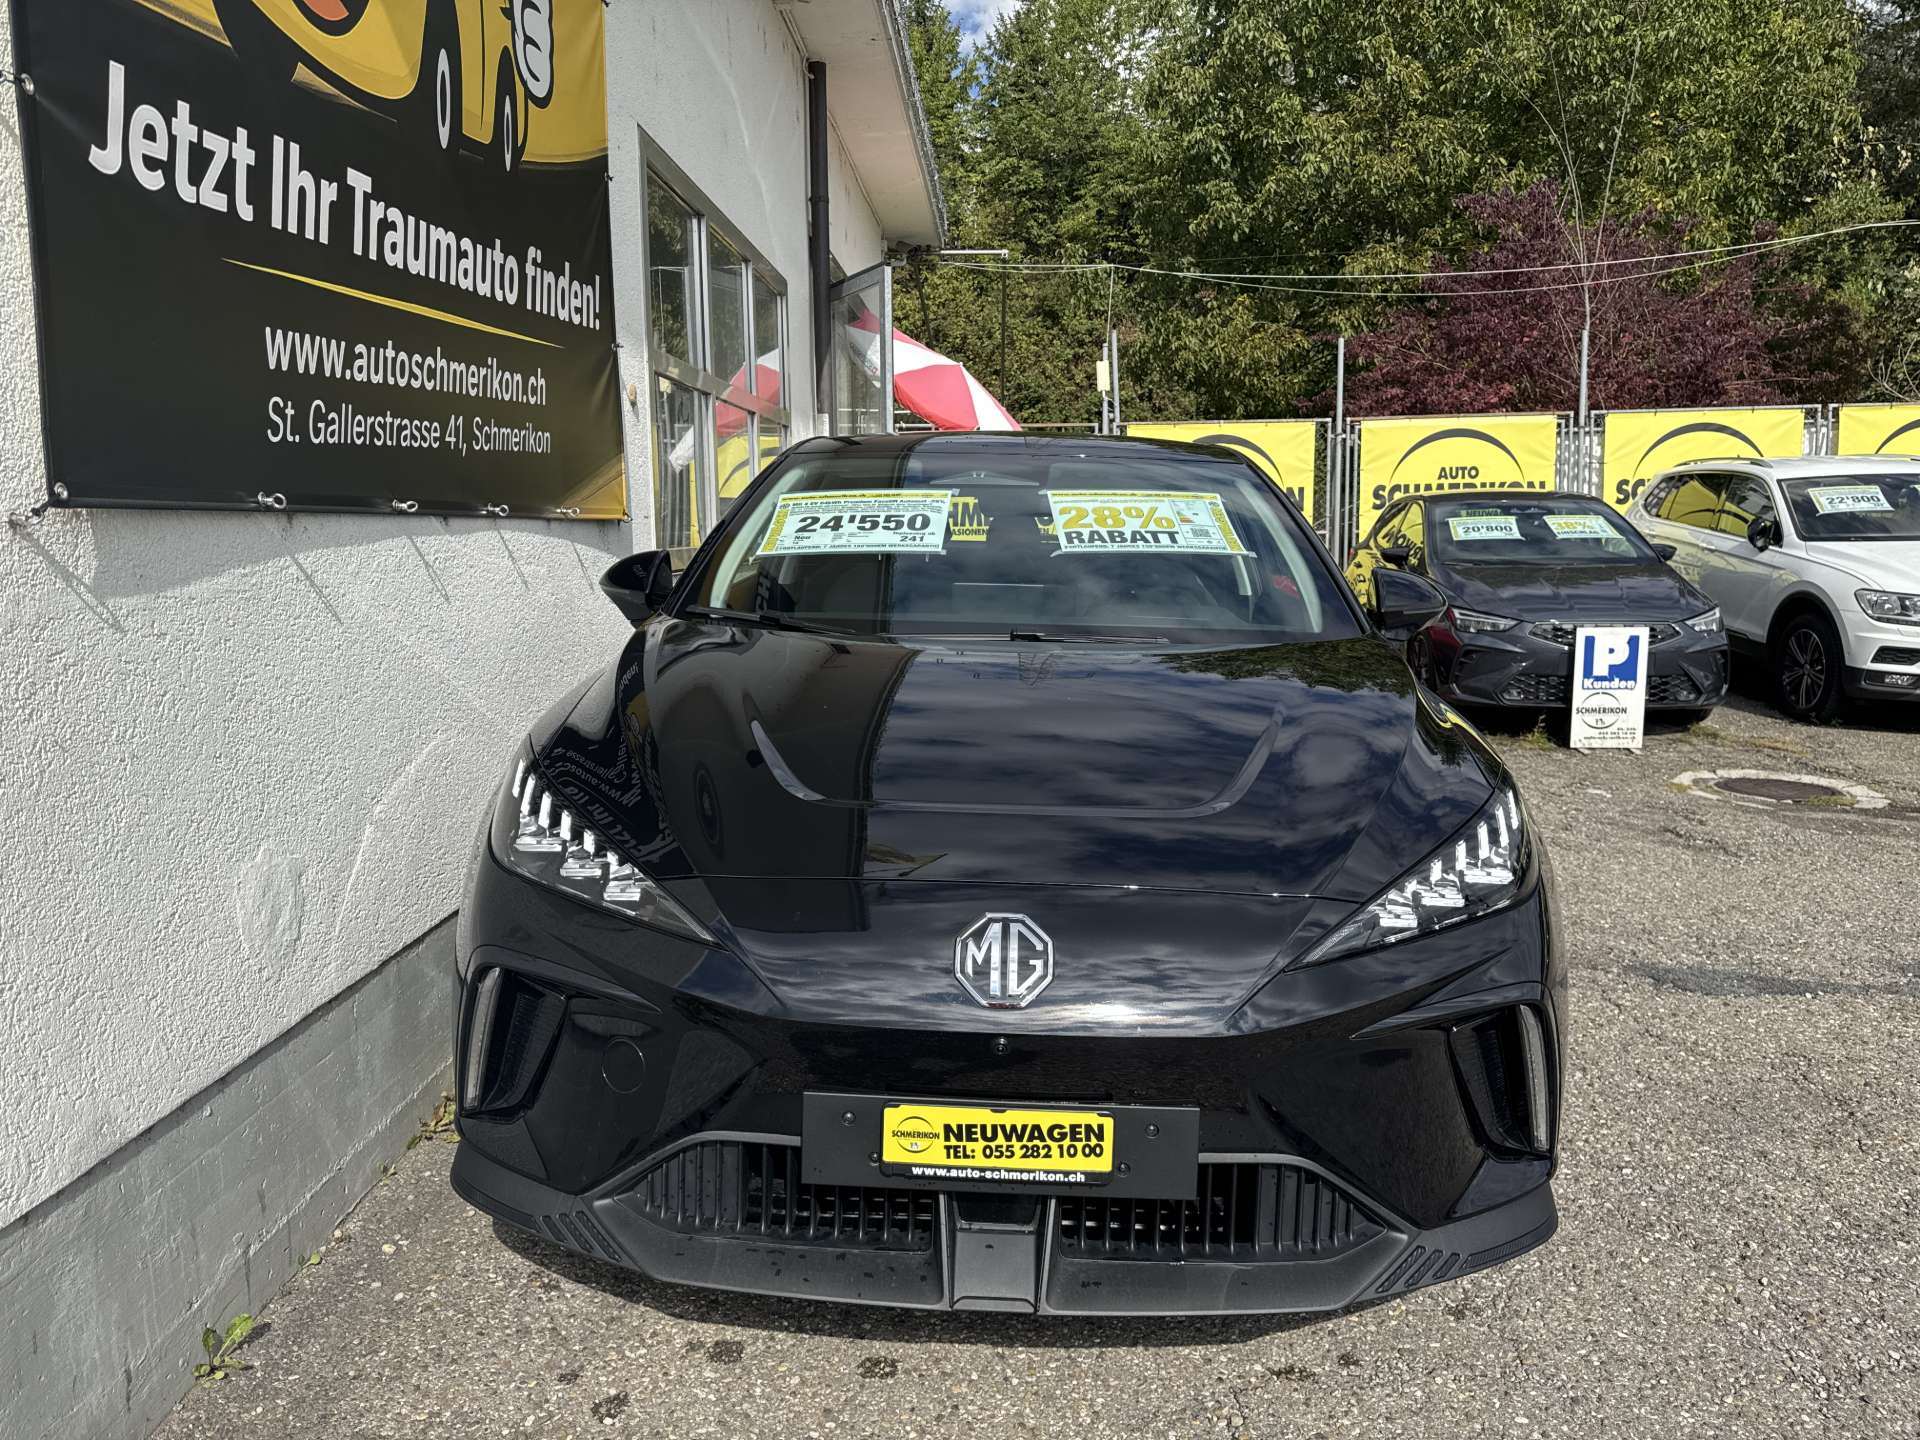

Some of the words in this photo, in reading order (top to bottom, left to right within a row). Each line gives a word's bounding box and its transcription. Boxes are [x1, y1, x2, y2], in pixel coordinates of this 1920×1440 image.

[89, 59, 255, 222] Jetzt
[271, 134, 338, 245] Ihr
[346, 166, 519, 305] Traumauto
[525, 245, 600, 331] finden!
[265, 326, 546, 406] www.autoschmerikon.ch
[267, 396, 300, 443] St.
[309, 399, 440, 449] Gallerstrasse
[445, 414, 467, 457] 41,
[472, 416, 551, 454] Schmerikon
[1437, 466, 1480, 480] AUTO
[1826, 495, 1881, 505] 22'800
[794, 513, 932, 534] 24'550
[1058, 505, 1176, 530] 28%
[1063, 530, 1180, 545] RABATT
[1461, 525, 1513, 534] 20'800
[1592, 634, 1630, 677] P
[1583, 677, 1636, 690] Kunden
[1575, 706, 1628, 715] SCHMERIKON
[964, 920, 1044, 999] MG
[891, 1129, 940, 1140] SCHMERIKON
[943, 1123, 1105, 1143] NEUWAGEN
[944, 1144, 975, 1159] TEL:
[982, 1144, 1015, 1159] 055
[1019, 1143, 1053, 1159] 282
[1058, 1143, 1078, 1159] 10
[1081, 1143, 1104, 1158] 00
[911, 1166, 1086, 1183] www.auto-schmerikon.ch
